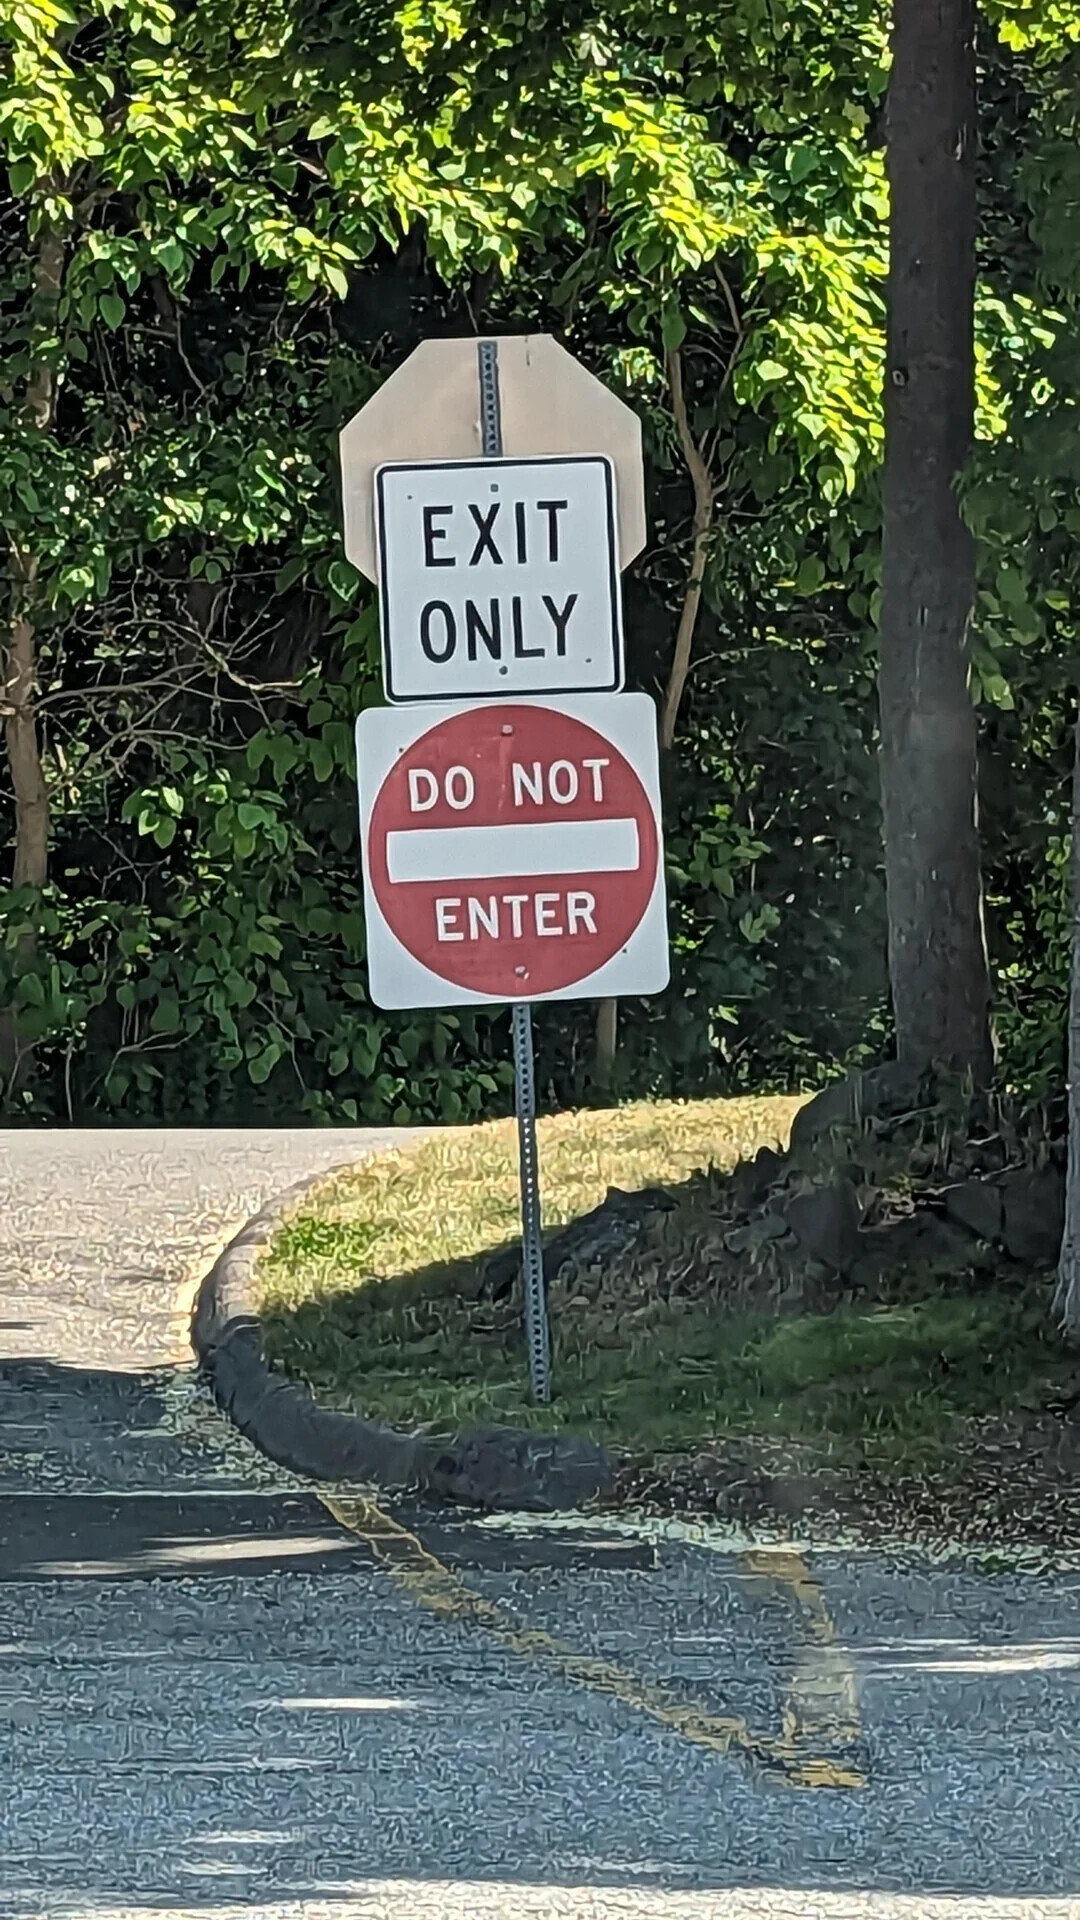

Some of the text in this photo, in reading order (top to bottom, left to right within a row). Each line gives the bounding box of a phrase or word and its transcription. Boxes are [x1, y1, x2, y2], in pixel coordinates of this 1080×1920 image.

[423, 499, 568, 568] EXIT
[421, 594, 578, 664] ONLY
[408, 758, 610, 812] DO NOT
[435, 891, 598, 942] ENTER
